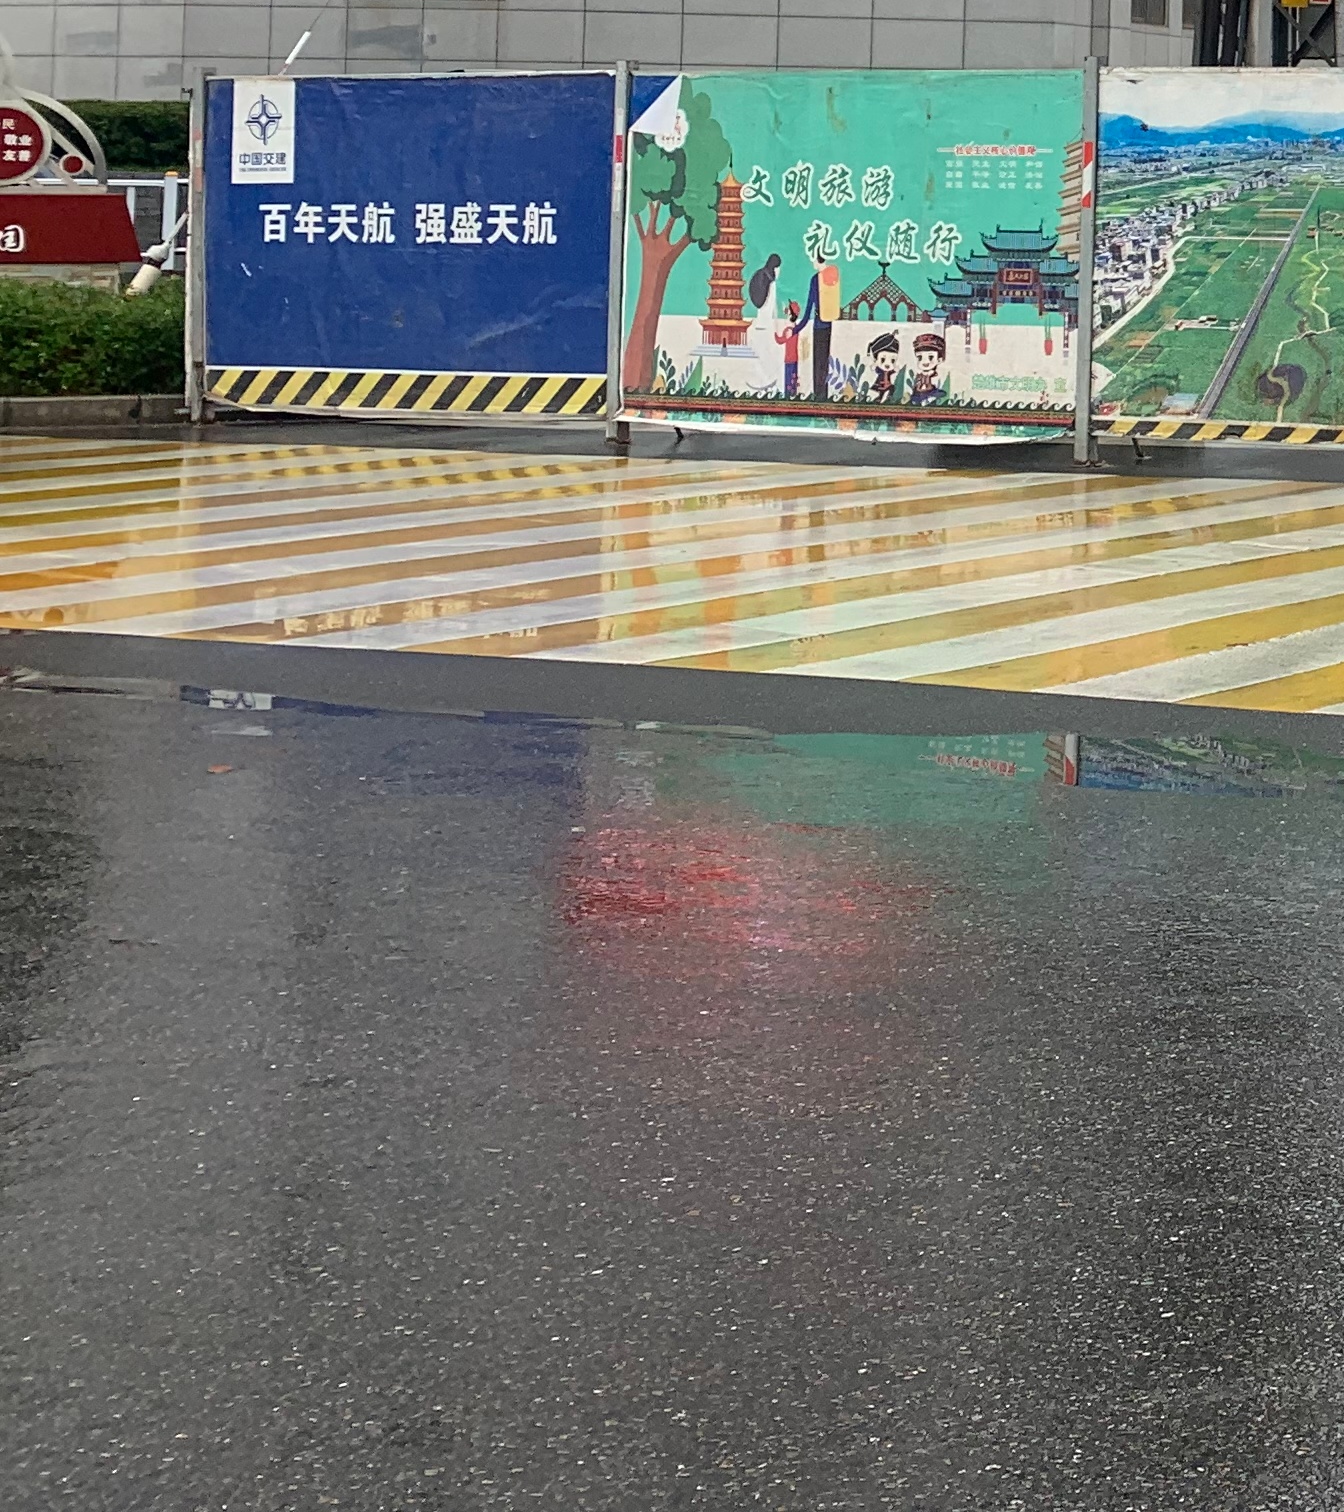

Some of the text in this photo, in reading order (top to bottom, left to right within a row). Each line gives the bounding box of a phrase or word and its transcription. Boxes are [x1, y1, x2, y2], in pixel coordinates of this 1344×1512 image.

[239, 152, 287, 166] 中国交建
[743, 164, 894, 209] 文明旅游
[259, 201, 558, 245] 百年天航 强盛天航
[804, 221, 960, 264] 礼仪随行
